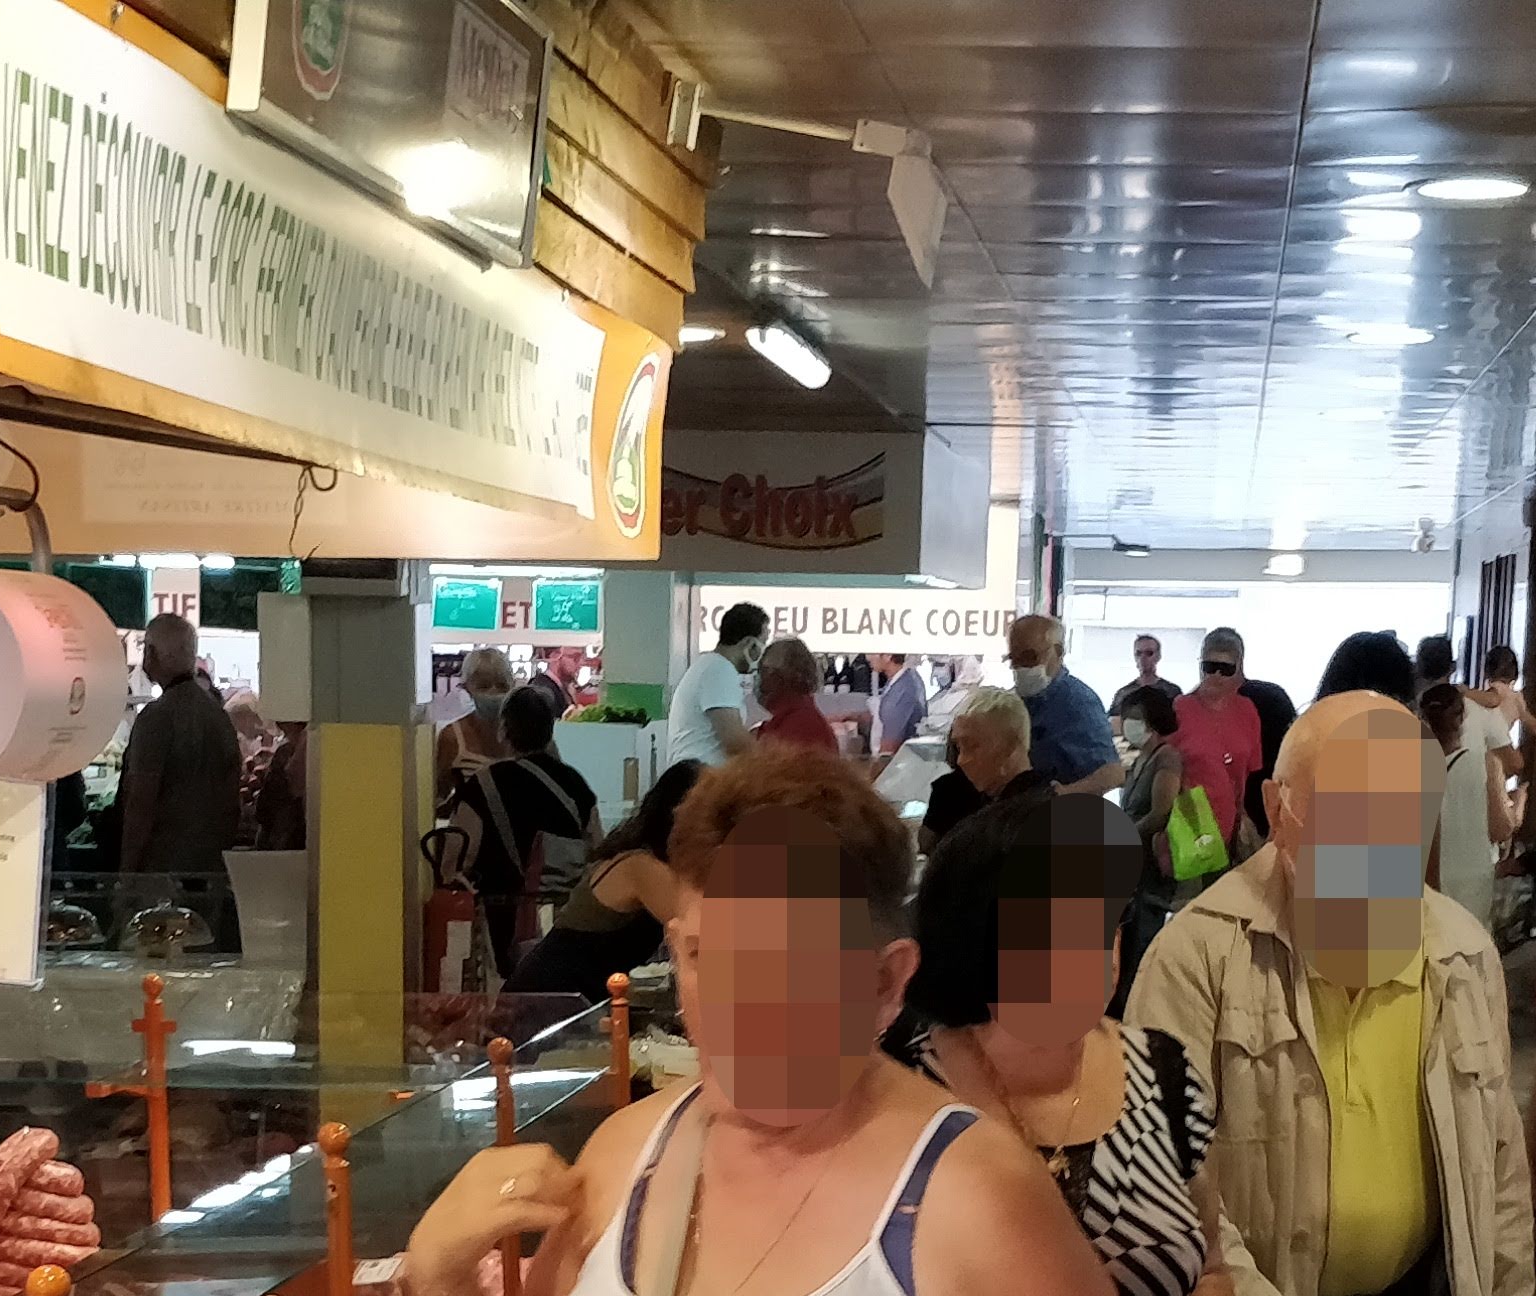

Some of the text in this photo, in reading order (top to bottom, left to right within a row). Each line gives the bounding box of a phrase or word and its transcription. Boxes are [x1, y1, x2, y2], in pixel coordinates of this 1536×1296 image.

[3, 62, 73, 283] VENEZ
[184, 163, 217, 336] LE
[208, 177, 265, 356] PORC
[720, 473, 857, 539] Choix
[501, 600, 533, 630] ET
[821, 606, 912, 635] BLANC
